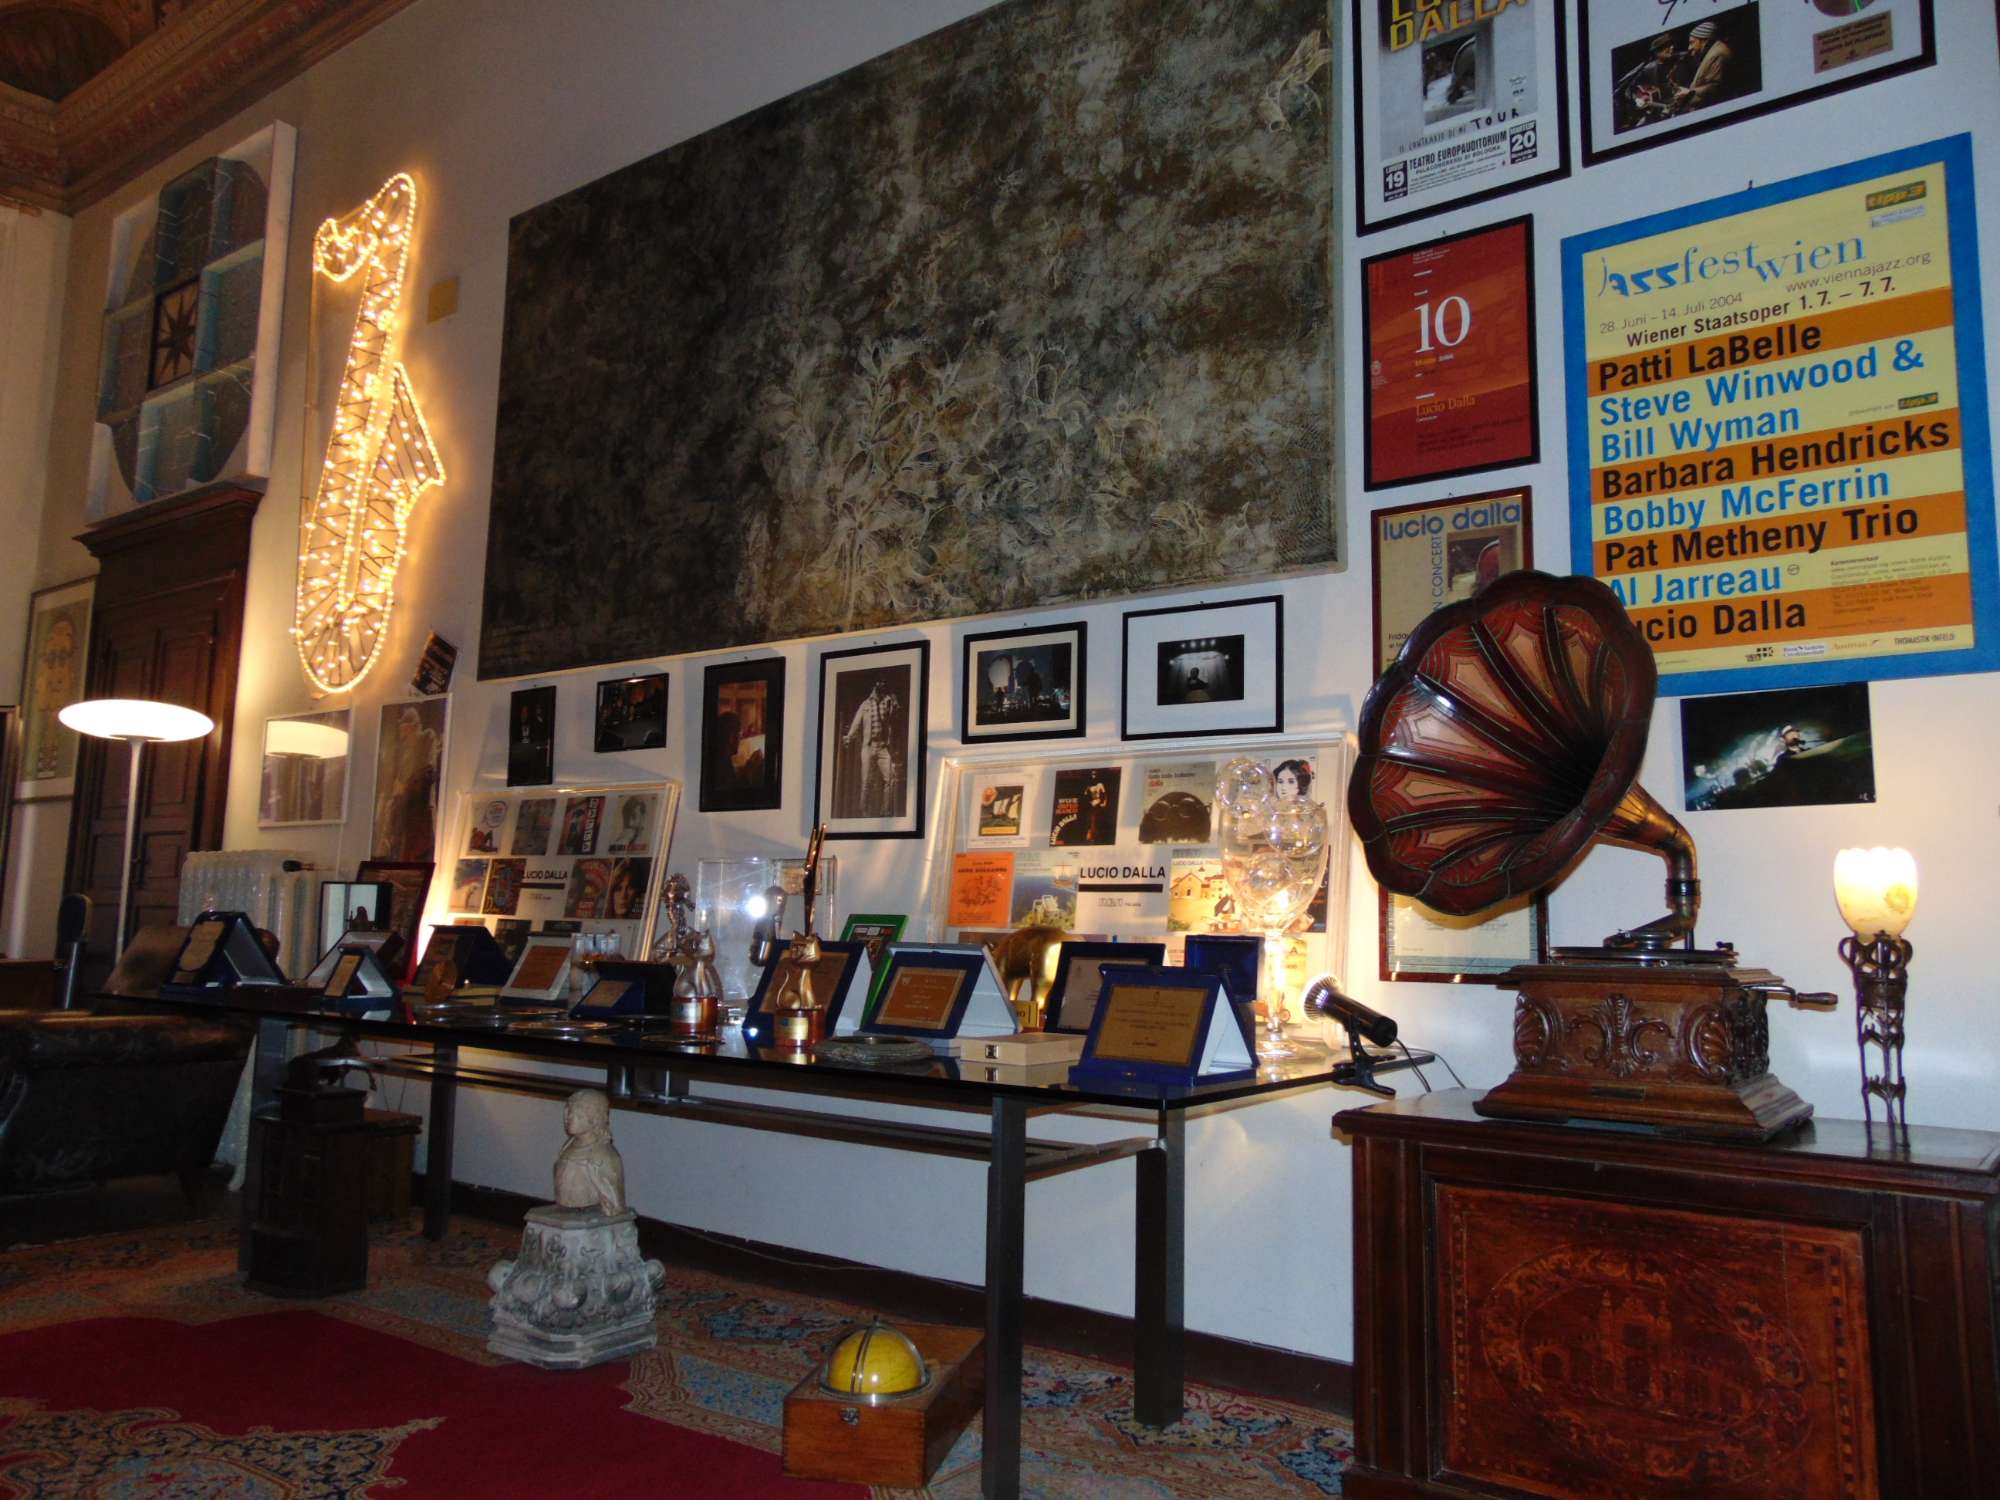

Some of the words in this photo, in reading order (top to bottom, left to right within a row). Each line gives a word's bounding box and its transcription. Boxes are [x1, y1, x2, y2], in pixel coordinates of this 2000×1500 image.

[1470, 107, 1520, 131] TOUR
[1409, 152, 1436, 170] TEATRO
[1437, 130, 1508, 162] EUROPAUDITORIUM
[1511, 130, 1536, 153] 20
[1386, 171, 1405, 190] 19
[1786, 252, 1931, 293] www.viennajazz.org
[1414, 296, 1471, 353] 10
[1621, 313, 1646, 329] Juni
[1684, 301, 1705, 315] Juli
[1710, 292, 1743, 310] 2004
[1627, 325, 1687, 348] Wiener
[1694, 302, 1790, 334] Staatsoper
[1600, 349, 1672, 391] Patti
[1688, 323, 1822, 374] LaBelle
[1600, 389, 1691, 426] Steve
[1706, 346, 1878, 407] Winwood
[1892, 339, 1925, 372] &
[1415, 400, 1446, 416] Lucio
[1448, 395, 1476, 408] Dalla
[1602, 426, 1654, 462] Bill
[1670, 407, 1800, 452] Wyman
[1603, 457, 1735, 499] Barbara
[1751, 420, 1950, 476] Hendricks
[1383, 512, 1444, 541] lucio
[1452, 502, 1521, 530] dalla
[1604, 496, 1706, 535] Bobby
[1721, 467, 1889, 519] McFerrin
[1606, 539, 1659, 571] Pat
[1672, 517, 1828, 563] Metheny
[1842, 504, 1918, 540] Trio
[1432, 536, 1443, 598] CONCERT
[1610, 577, 1636, 607] Al
[1652, 566, 1781, 604] Jarreau
[1714, 599, 1806, 635] Dalla
[521, 870, 543, 880] LUCIO
[544, 870, 568, 880] DALLA
[1079, 866, 1118, 879] LUCIO
[1122, 866, 1166, 878] DALLA
